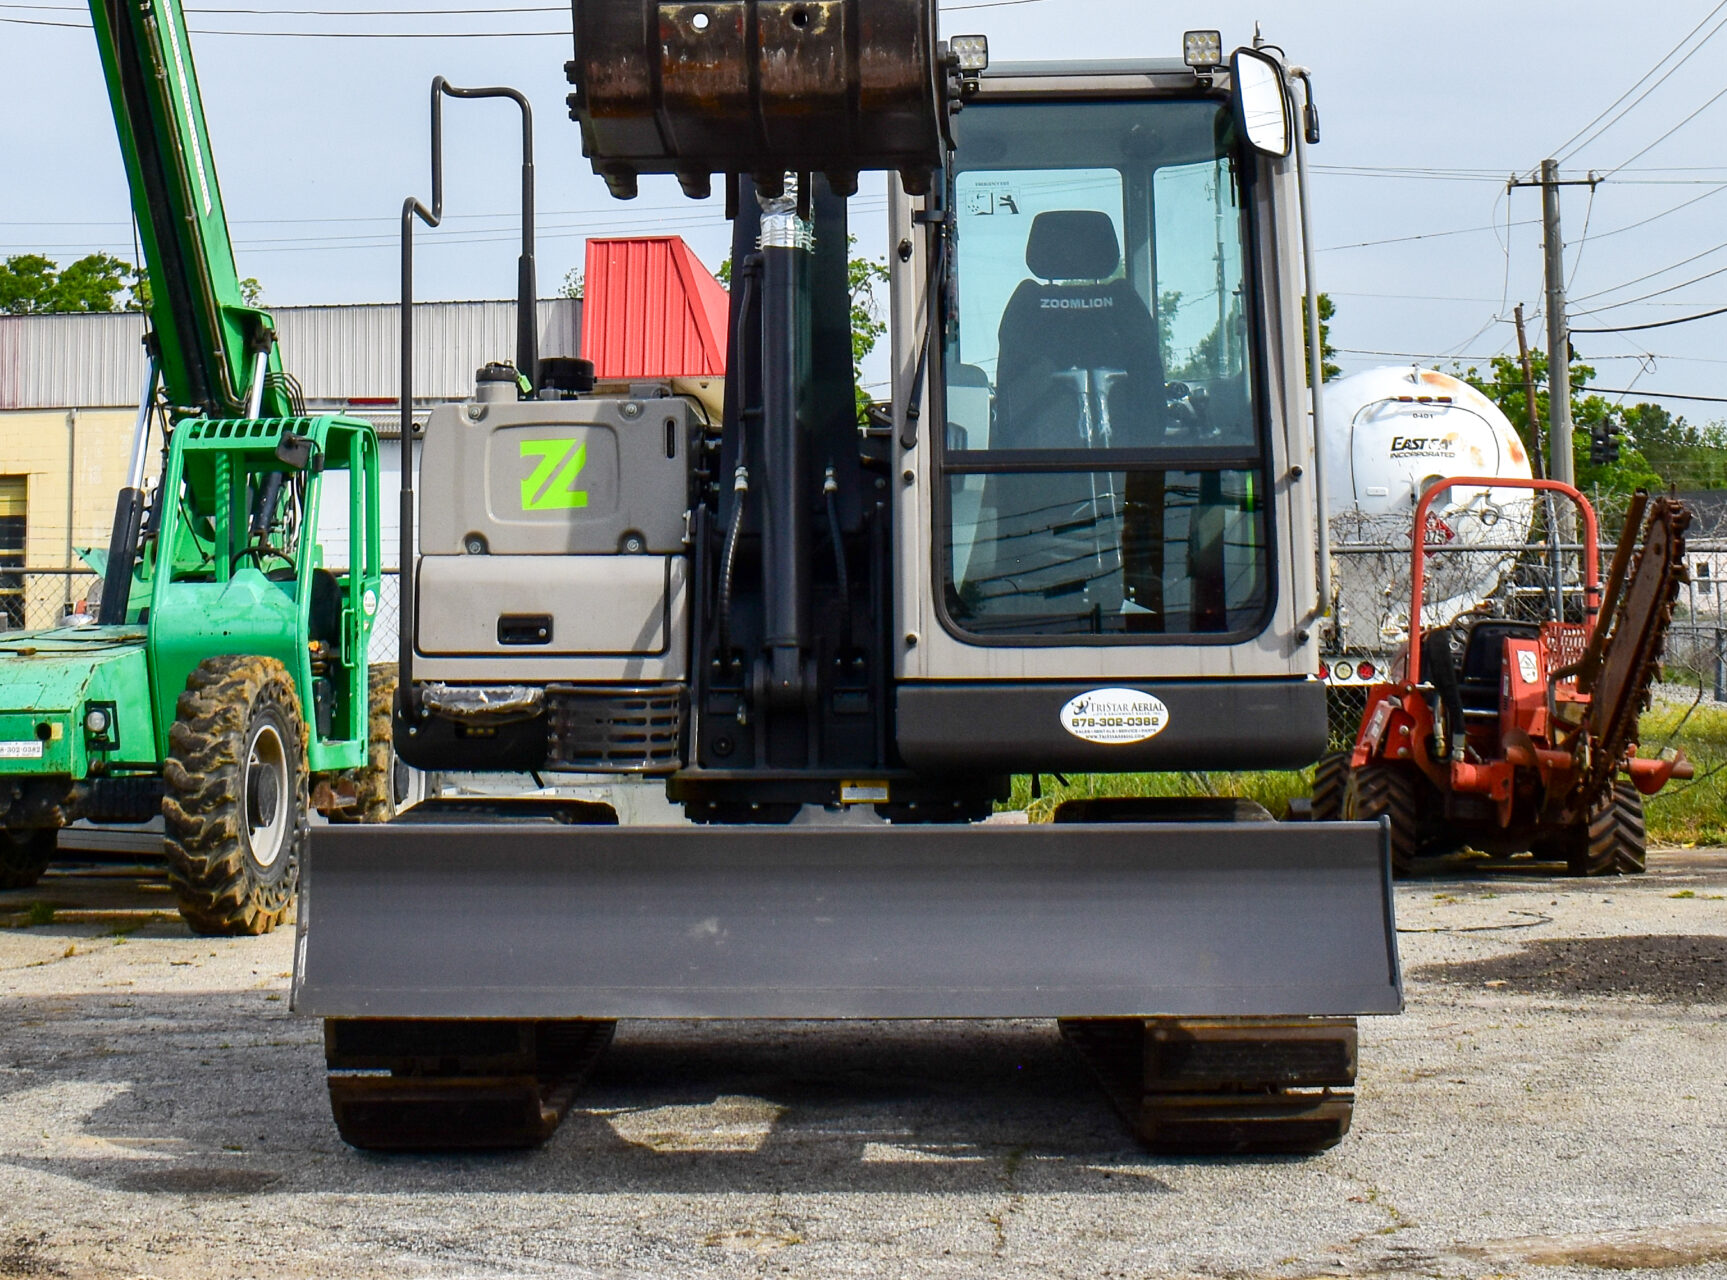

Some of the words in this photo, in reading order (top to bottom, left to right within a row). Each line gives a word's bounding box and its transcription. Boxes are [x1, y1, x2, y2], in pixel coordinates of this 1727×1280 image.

[1040, 297, 1113, 309] ZOOMLION
[1391, 436, 1428, 451] EAST
[1131, 702, 1164, 712] AERIAL
[1072, 717, 1159, 727] 678-302-0382
